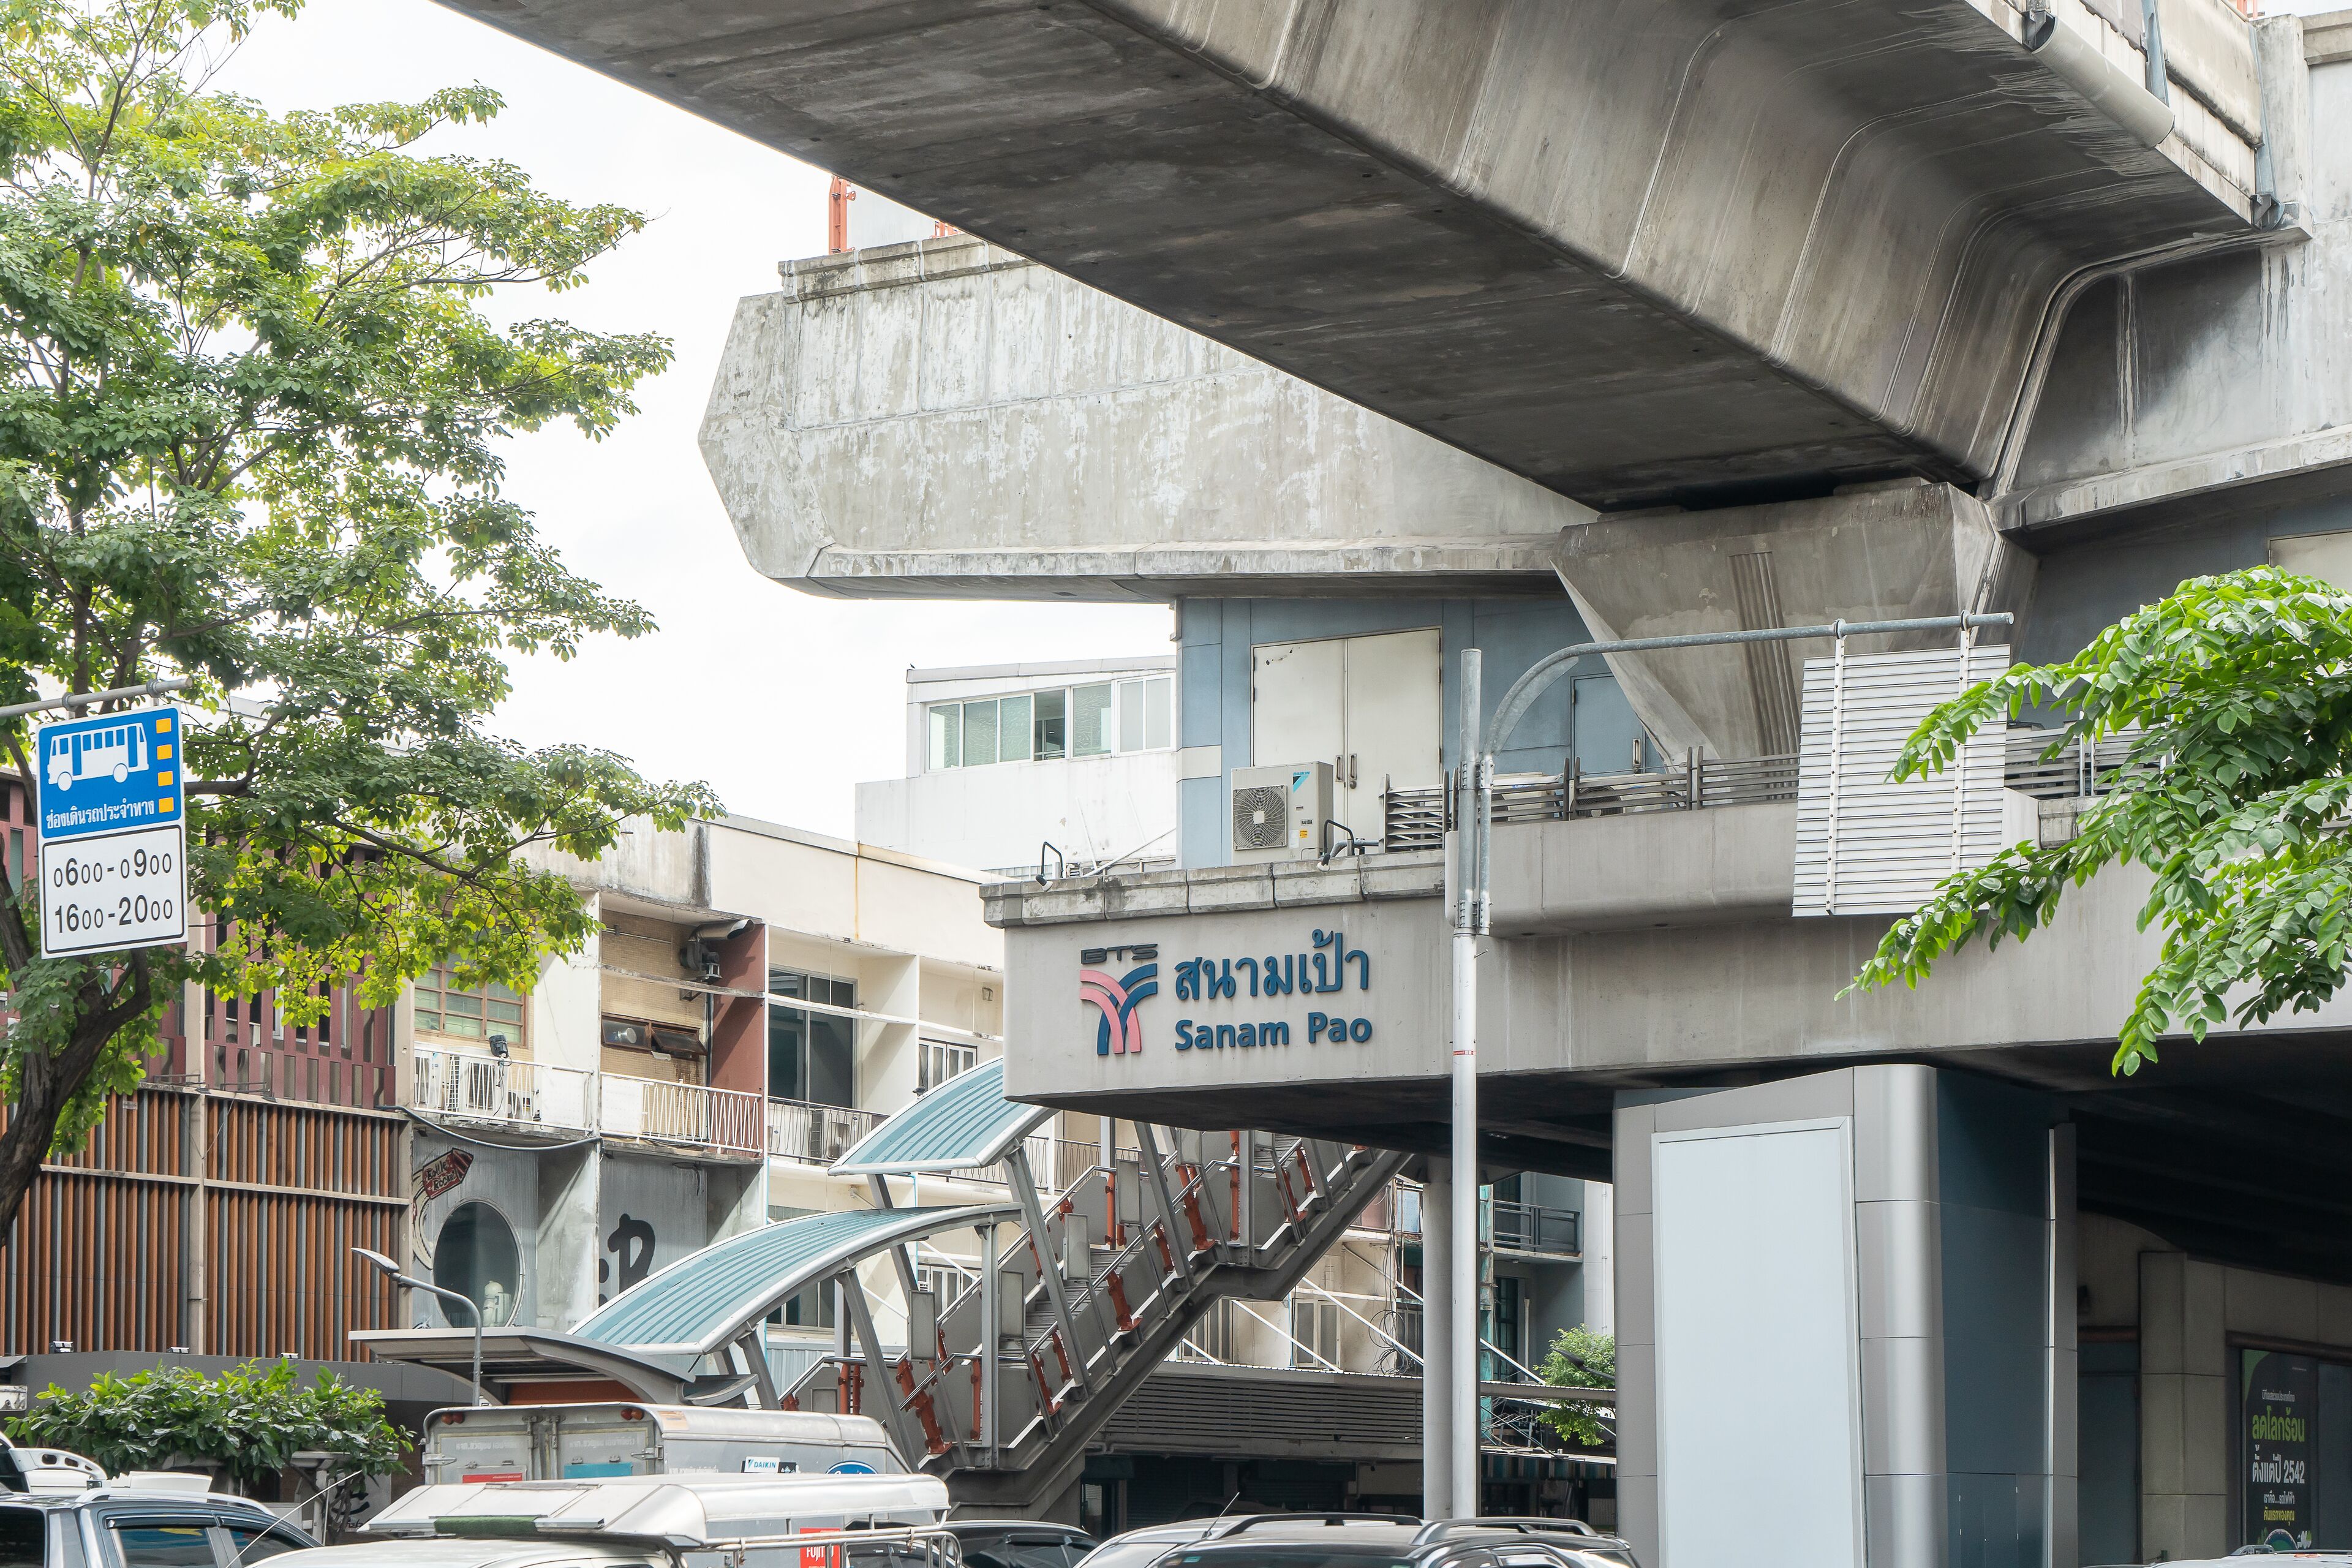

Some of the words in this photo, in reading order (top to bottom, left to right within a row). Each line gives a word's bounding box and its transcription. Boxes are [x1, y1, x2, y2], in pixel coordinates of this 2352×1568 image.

[46, 798, 155, 829] ช่องเดินรถประจำทาง
[1080, 943, 1158, 964] BTS
[1174, 929, 1369, 1000] สนามเป้า
[1175, 1019, 1289, 1050] Sanam
[1308, 1011, 1373, 1043] Pao
[2252, 1405, 2305, 1442] ลดโลกร้อน
[2252, 1444, 2282, 1483] ตั้งแต่ปี
[2283, 1460, 2305, 1483] 2542
[806, 1545, 834, 1562] FUJIT
